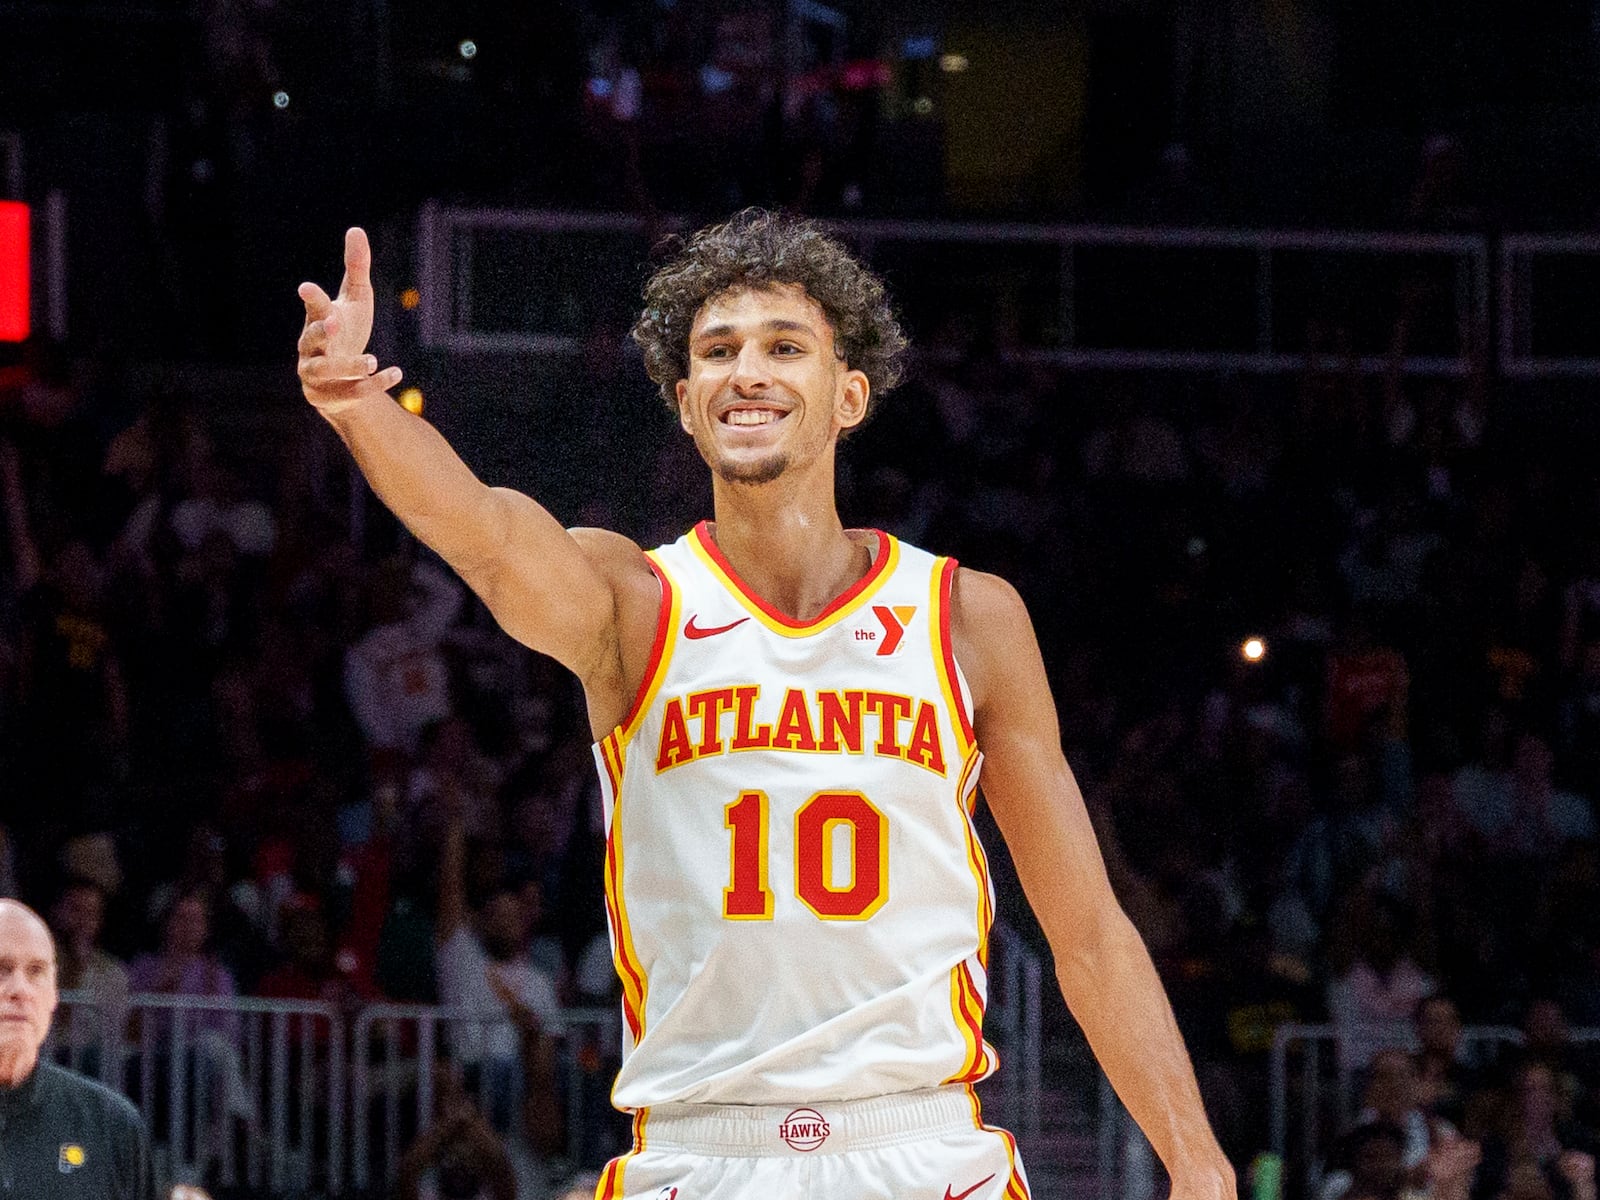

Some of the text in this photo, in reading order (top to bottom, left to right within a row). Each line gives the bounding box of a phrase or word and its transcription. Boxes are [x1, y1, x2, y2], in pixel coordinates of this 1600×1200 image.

[855, 628, 876, 640] the
[655, 684, 948, 778] ATLANTA
[722, 789, 889, 921] 10
[779, 1121, 831, 1138] HAWKS
